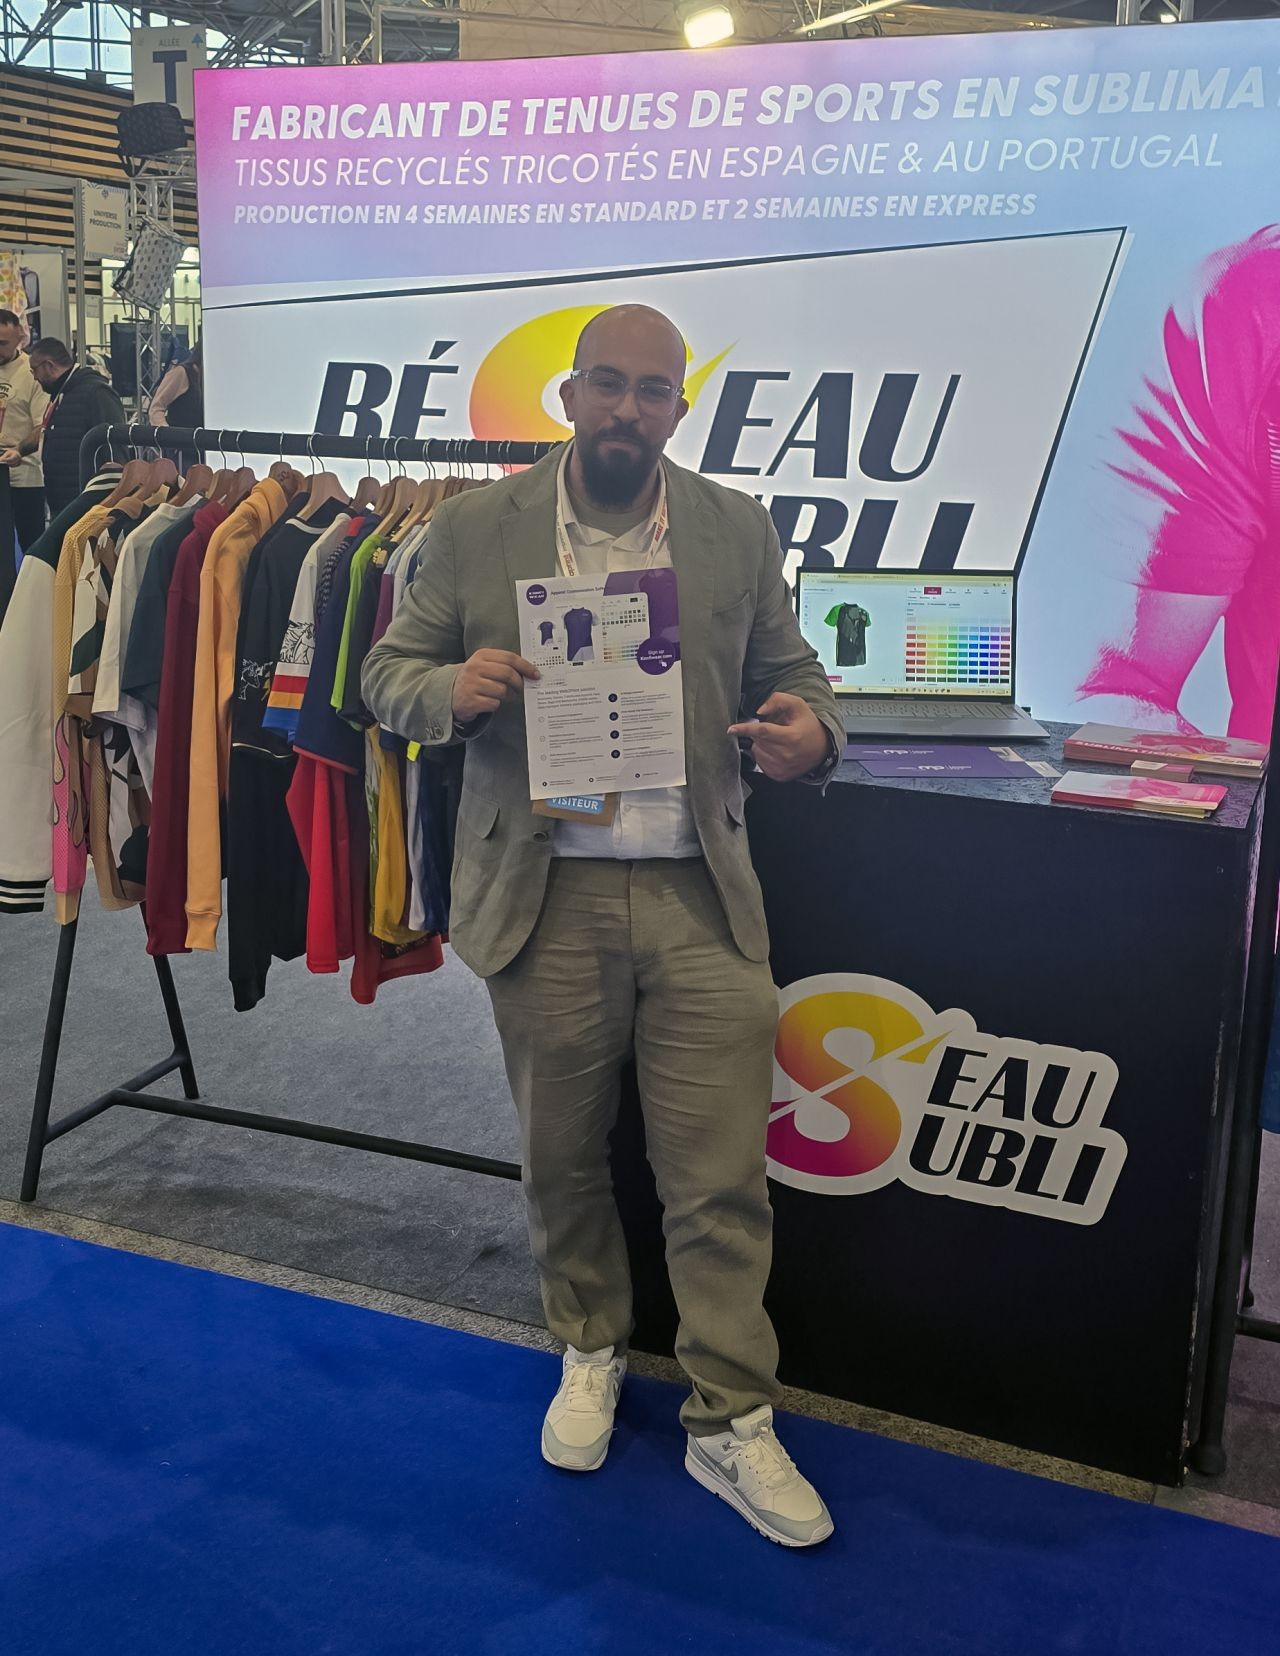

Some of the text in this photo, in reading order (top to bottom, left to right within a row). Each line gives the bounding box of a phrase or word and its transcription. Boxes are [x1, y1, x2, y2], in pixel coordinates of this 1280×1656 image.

[152, 50, 187, 104] T
[232, 66, 1280, 140] FABRICANT DE TENUES DE SPORTS EN SUBLIMA
[235, 133, 1223, 186] TISSUS RECYCLÉS TRICOTÉS EN ESPAGNE & AU PORTUGAL
[89, 218, 122, 230] PRODUCTION
[233, 193, 1037, 224] PRODUCTION EN 4 SEMAINES EN STANDARD ET 2 SEMAINES EN EXPRESS
[1076, 741, 1177, 758] SUBLIMATION
[552, 797, 599, 811] VISITEUR
